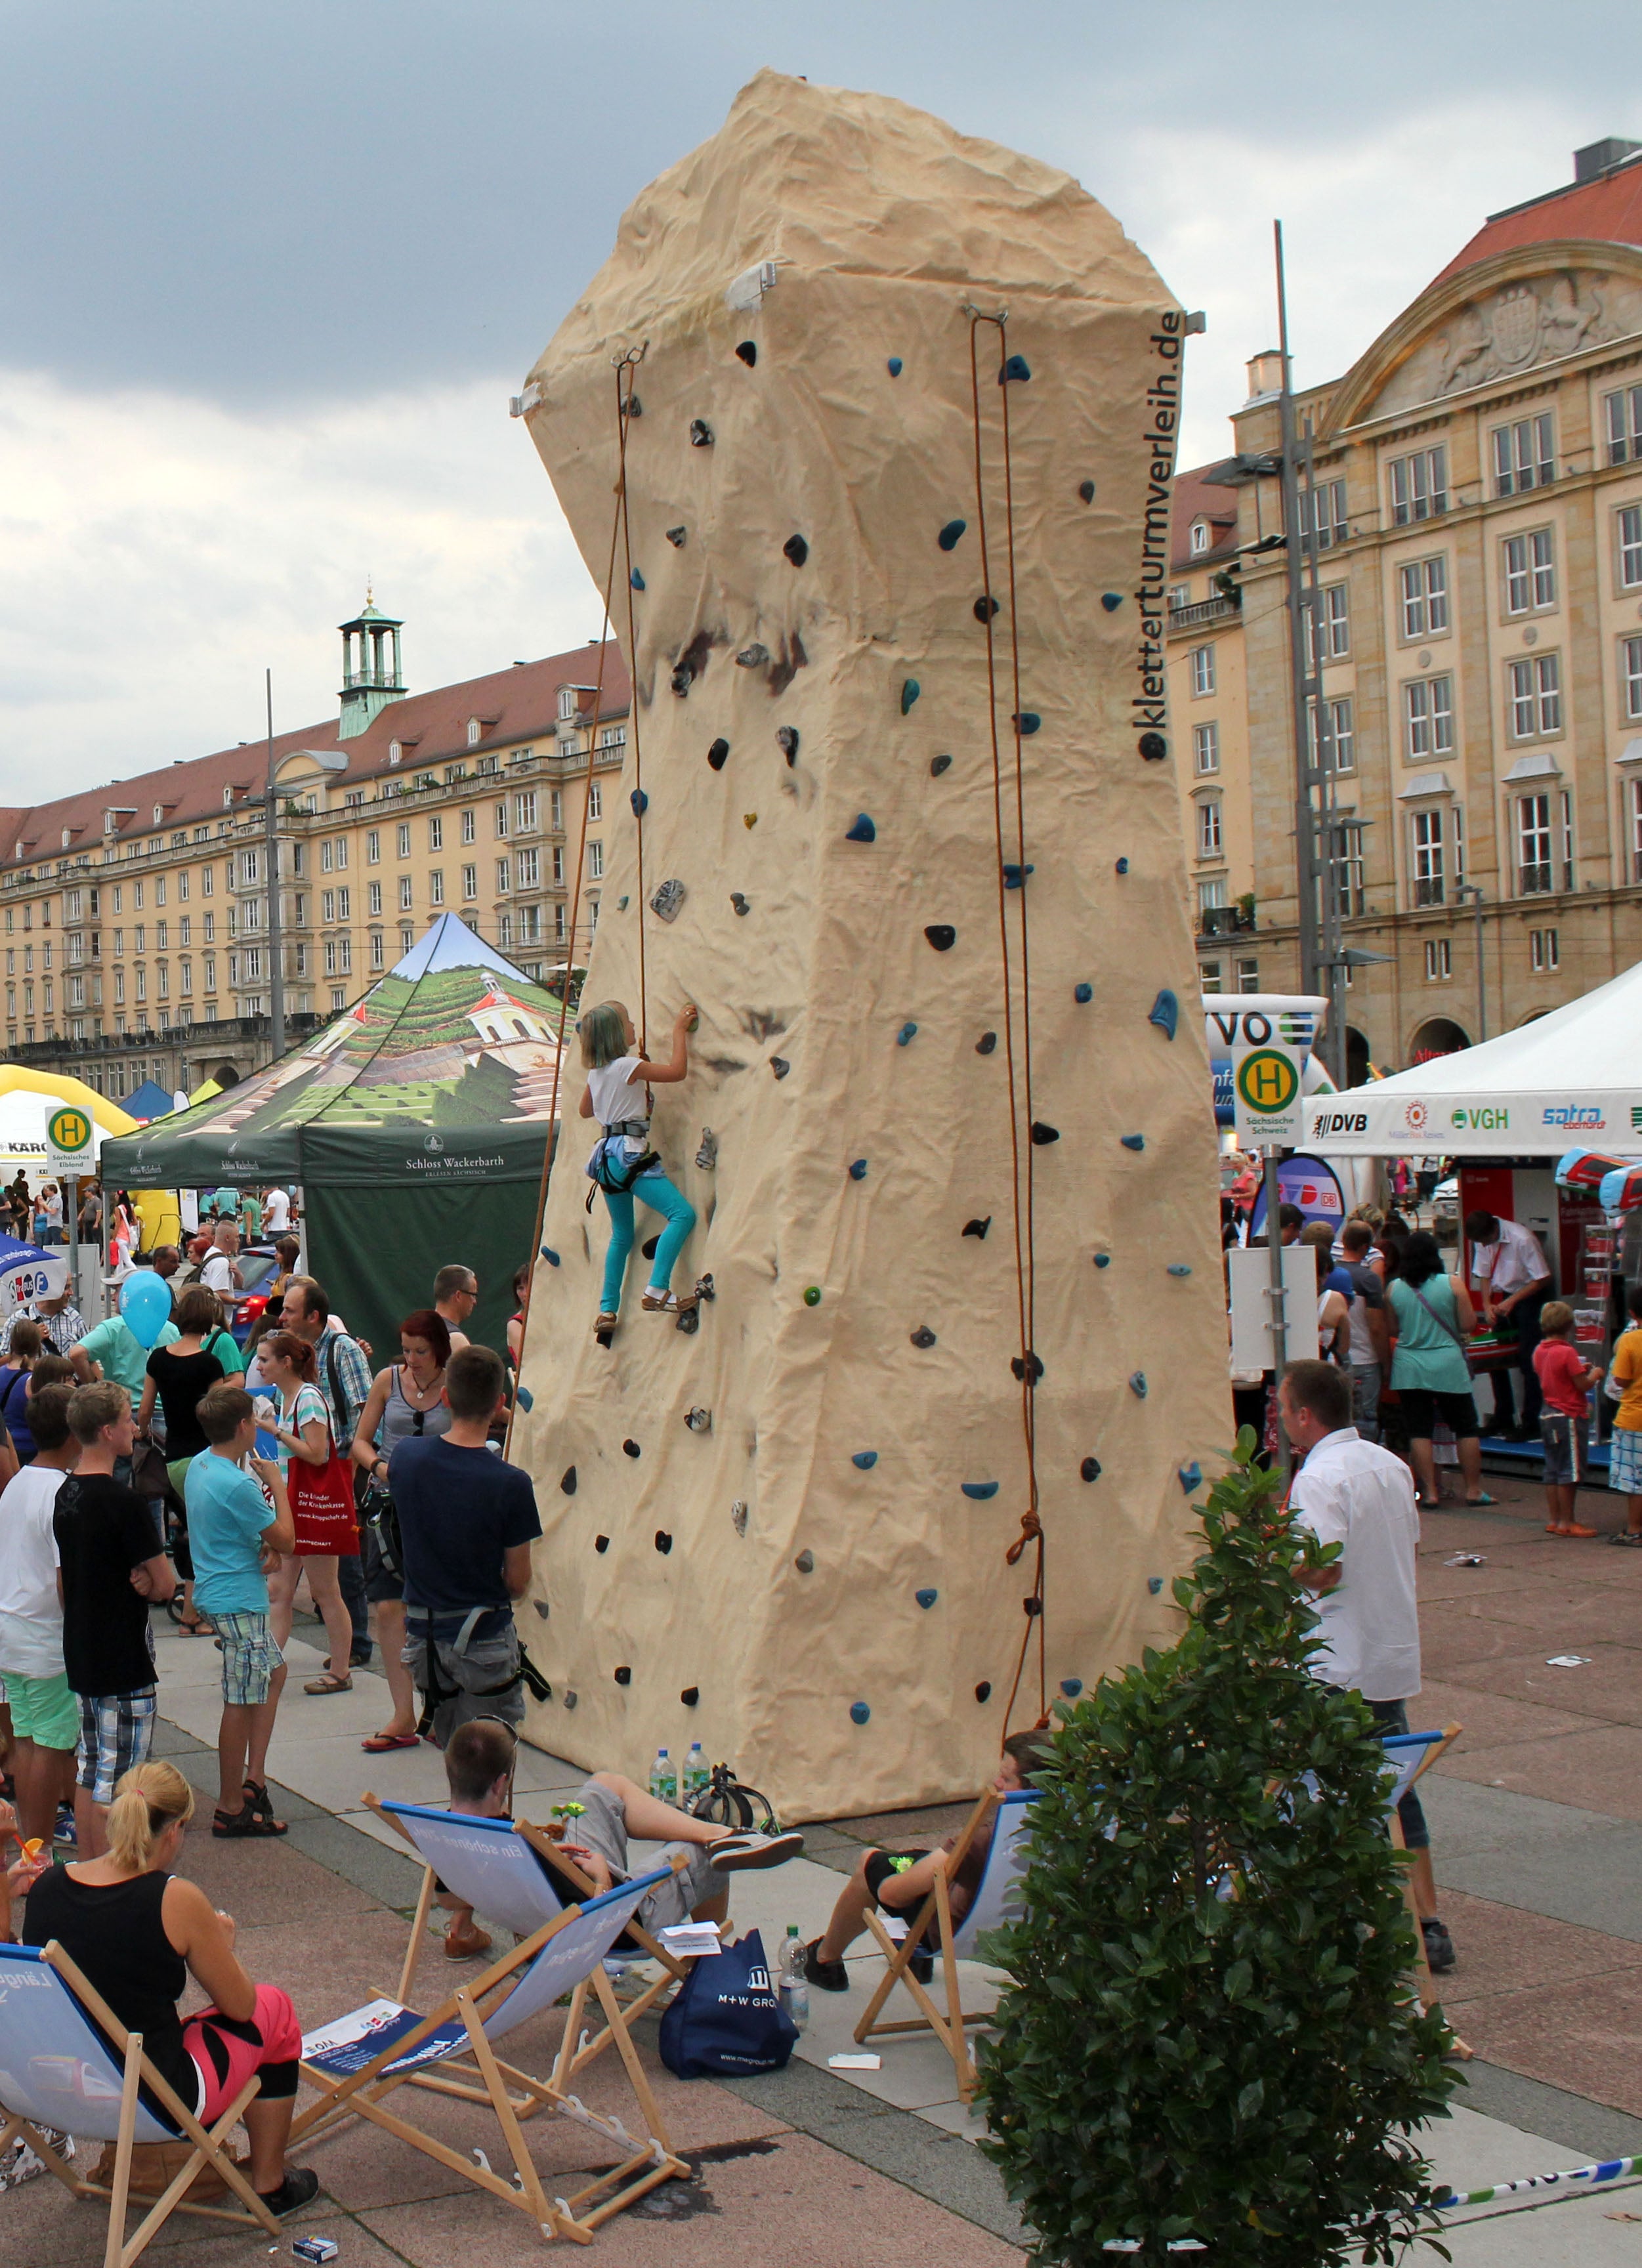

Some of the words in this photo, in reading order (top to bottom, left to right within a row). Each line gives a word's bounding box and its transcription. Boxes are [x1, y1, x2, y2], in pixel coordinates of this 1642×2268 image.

[1132, 310, 1181, 729] kletterturmverleih.de
[1206, 1011, 1272, 1046] VO
[1255, 1064, 1281, 1099] H
[1245, 1116, 1295, 1125] Sächsische
[1331, 1114, 1367, 1131] DVB
[1468, 1108, 1508, 1129] VGH
[1542, 1104, 1602, 1125] satra
[60, 1118, 79, 1142] H
[1251, 1126, 1289, 1135] Schweiz
[8, 1142, 47, 1152] KÄRC
[406, 1158, 442, 1169] Schloss
[443, 1155, 505, 1168] Wackerbarth
[718, 1994, 749, 2006] M+W
[752, 1998, 777, 2008] GRO
